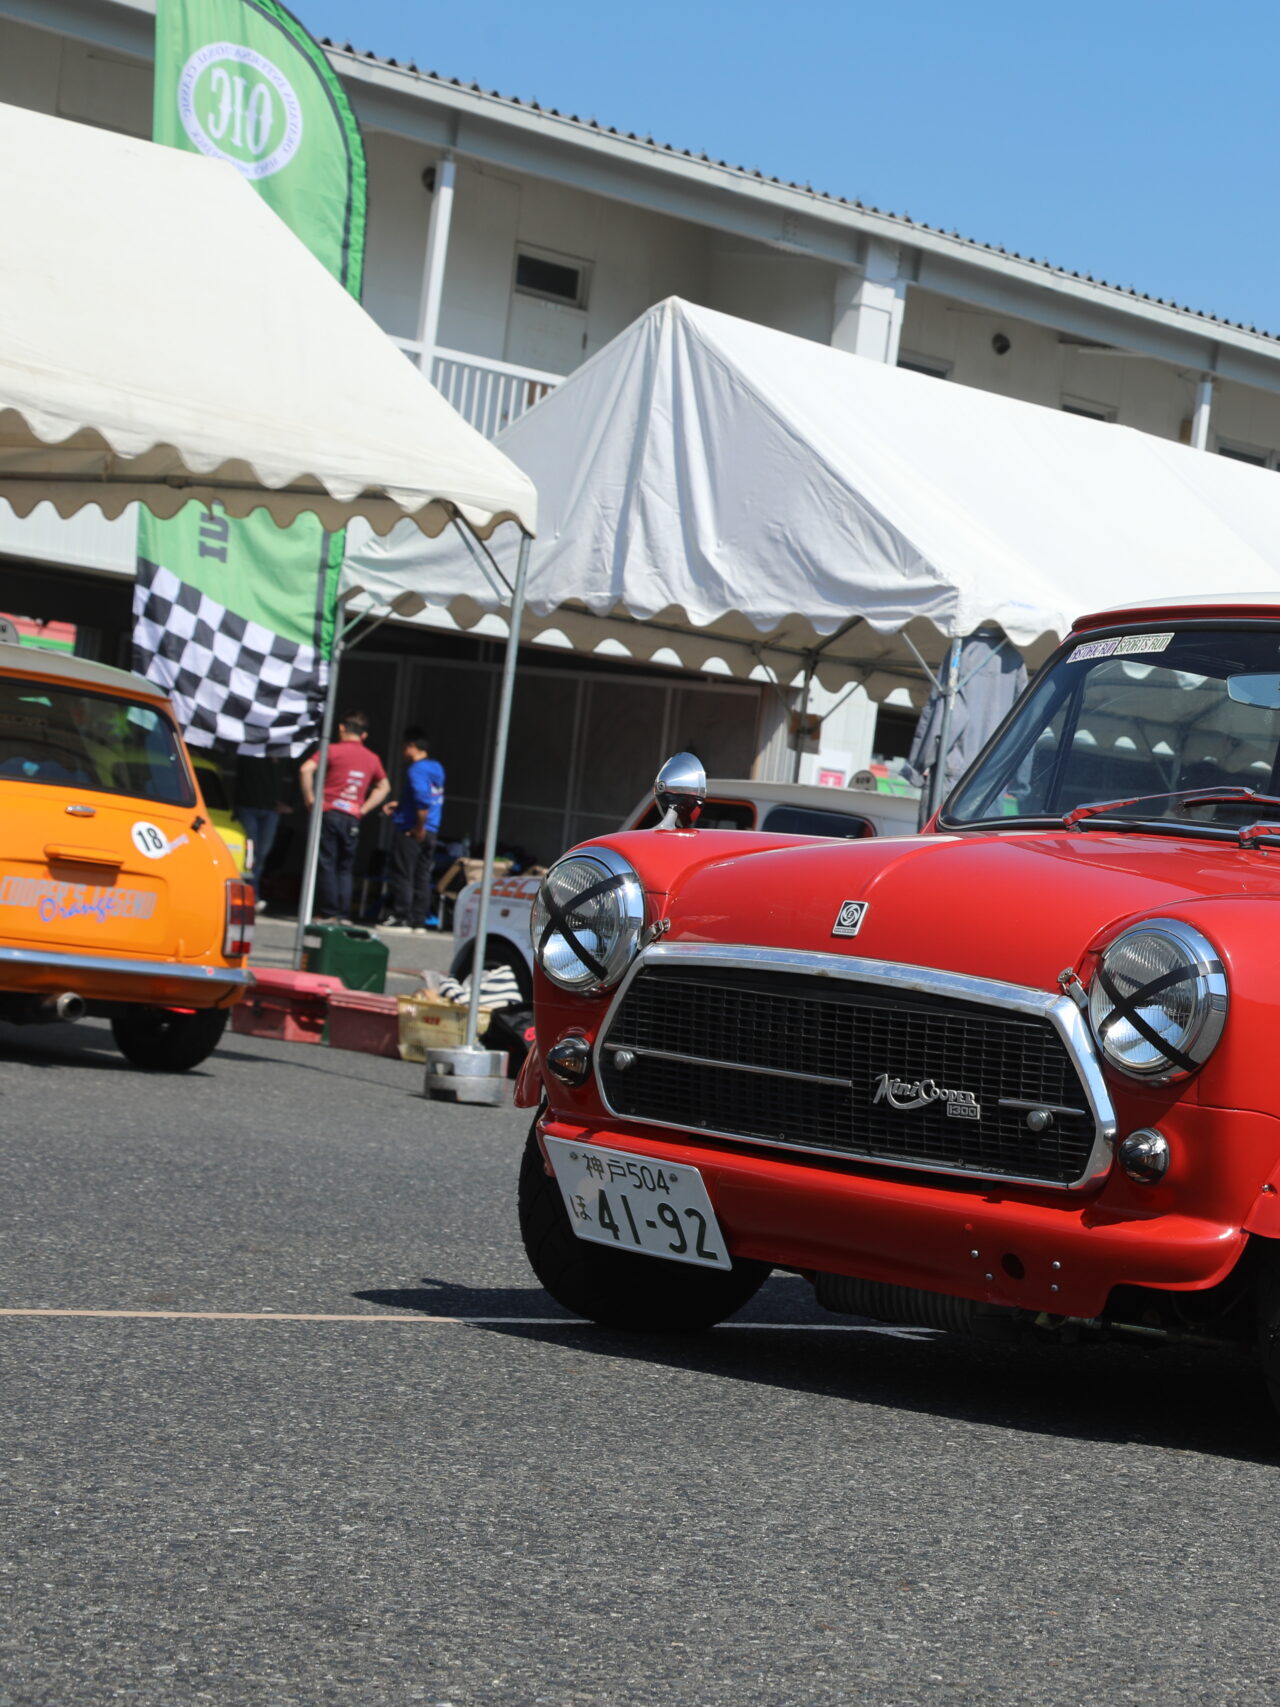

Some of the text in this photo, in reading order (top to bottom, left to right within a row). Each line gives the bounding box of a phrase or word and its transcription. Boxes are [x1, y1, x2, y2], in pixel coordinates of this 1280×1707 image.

[1116, 638, 1151, 653] SPORTS
[137, 827, 164, 852] 18
[39, 897, 116, 923] Orange
[949, 1105, 977, 1117] 1300
[569, 1189, 718, 1260] ほ 41-92
